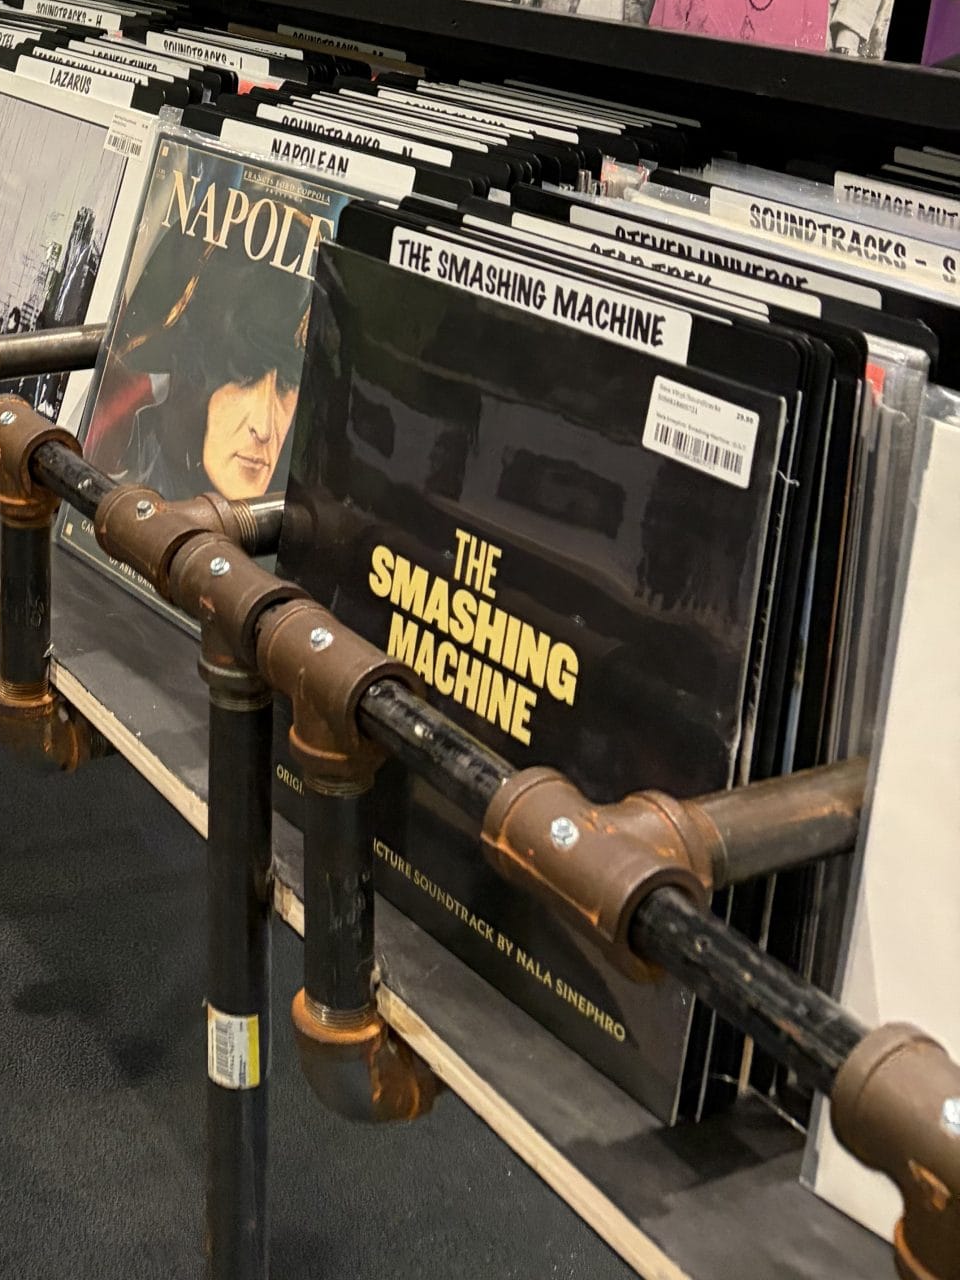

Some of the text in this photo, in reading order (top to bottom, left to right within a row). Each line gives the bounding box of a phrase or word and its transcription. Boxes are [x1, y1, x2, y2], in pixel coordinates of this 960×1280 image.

[36, 1, 87, 24] SOUNDTRACKS
[163, 39, 228, 65] SOUNDTRACKS
[49, 67, 92, 95] LAZARUS
[271, 136, 350, 173] NAPOLEAN
[244, 170, 275, 187] FRANCIS
[296, 184, 331, 203] COPPOLA
[843, 184, 913, 218] TEENAGE
[749, 203, 907, 270] SOUNDTRACKS
[942, 255, 957, 283] S
[398, 239, 667, 348] THE SMASHING MACHINE
[454, 528, 502, 599] THE
[369, 545, 579, 706] SMASHING
[387, 611, 538, 747] MACHINE
[276, 763, 305, 796] ORIGI
[373, 837, 626, 1043] ICTURE SOUNDTRACK BY NALA SINEPHRO
